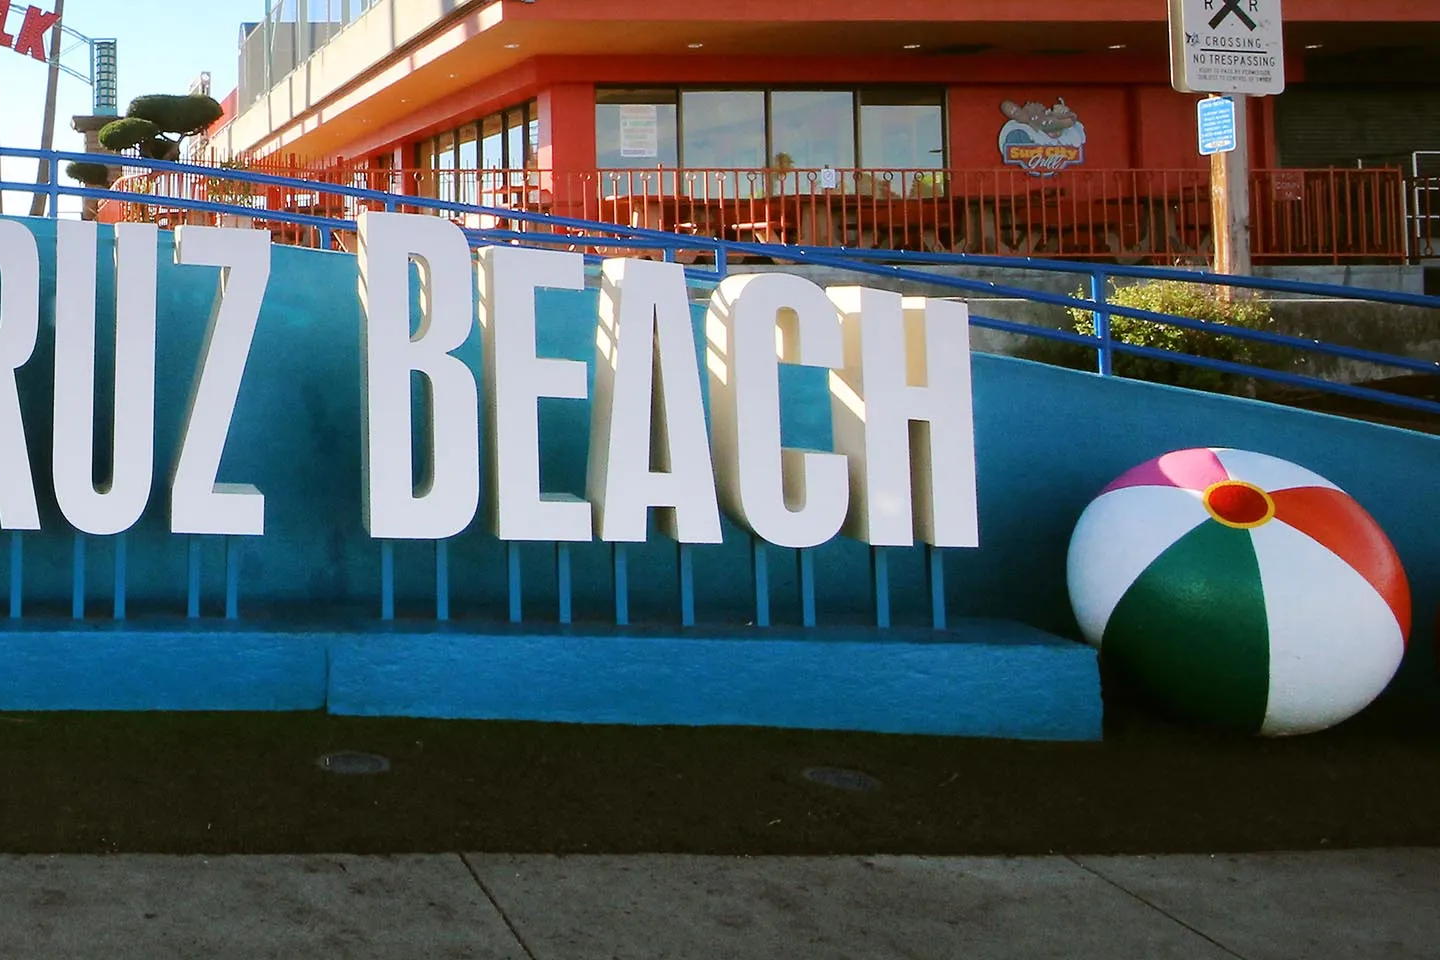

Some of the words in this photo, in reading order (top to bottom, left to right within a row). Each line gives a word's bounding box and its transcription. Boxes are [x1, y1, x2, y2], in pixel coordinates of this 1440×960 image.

[1205, 36, 1262, 50] CROSSING
[1193, 54, 1206, 64] NO
[1209, 54, 1276, 67] TRESPASSING
[356, 210, 979, 548] BEACH
